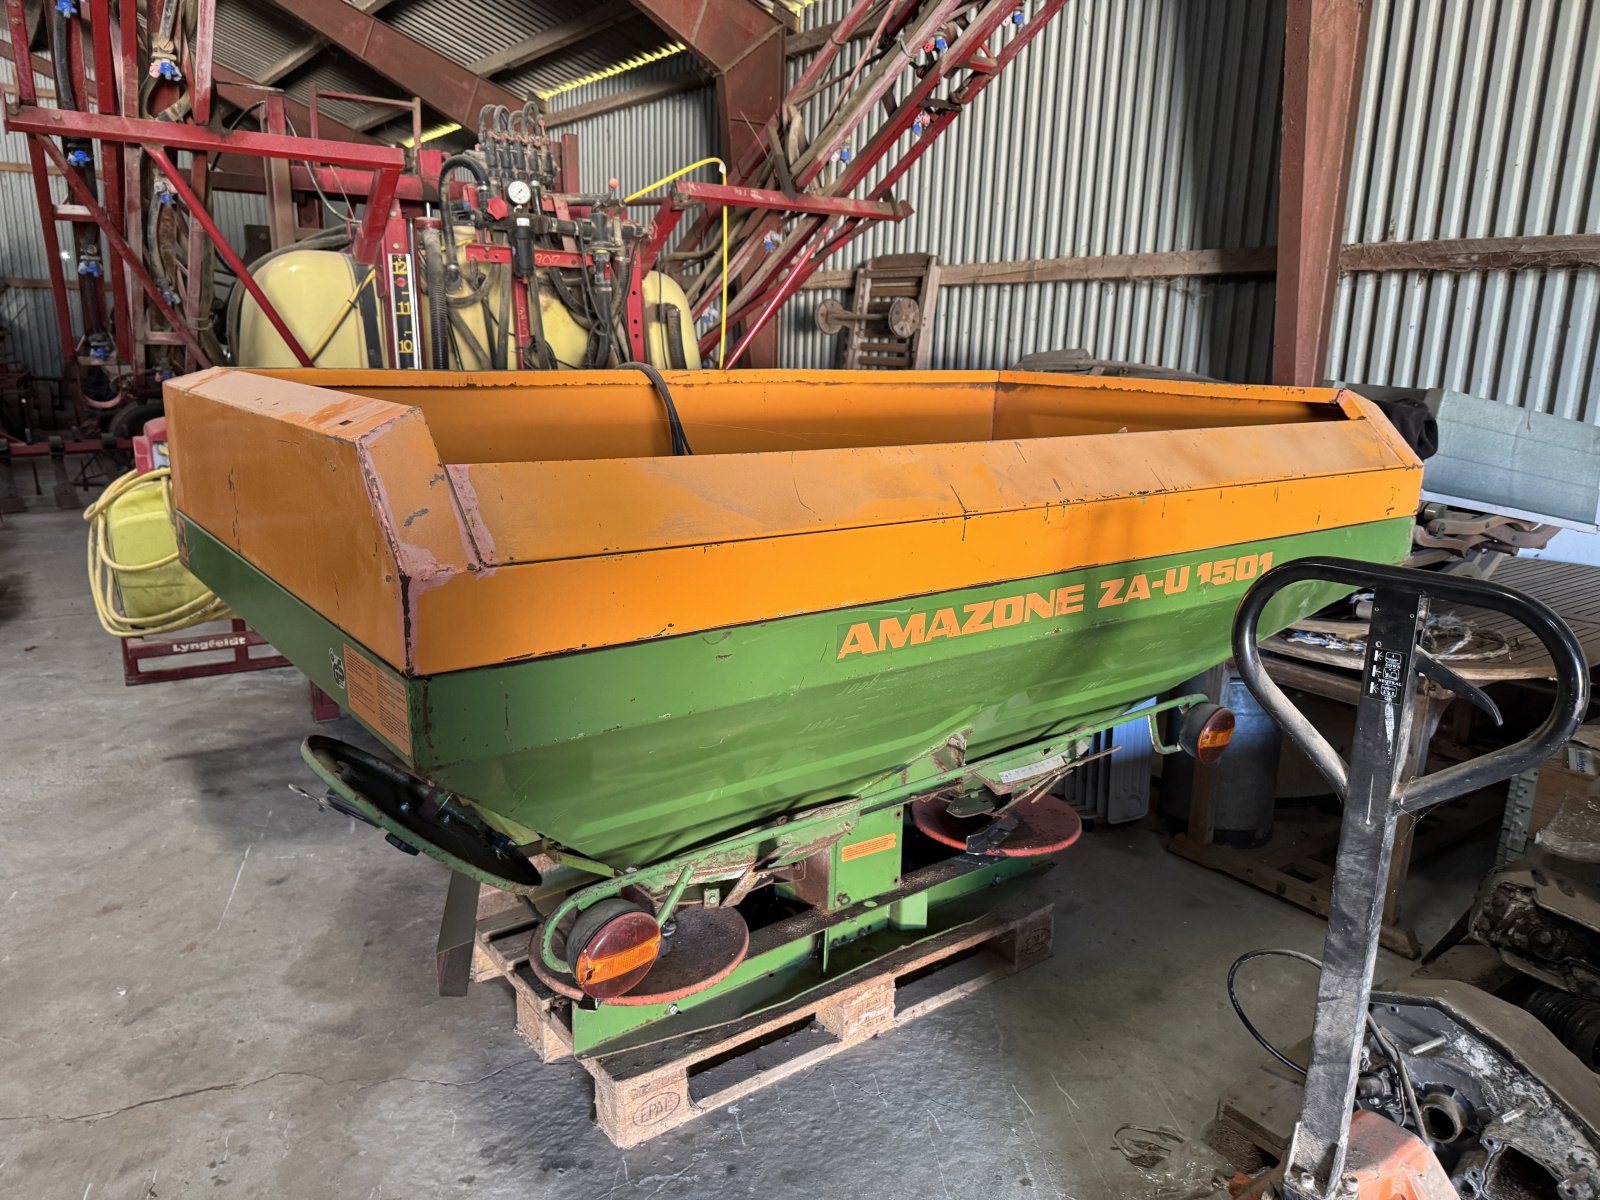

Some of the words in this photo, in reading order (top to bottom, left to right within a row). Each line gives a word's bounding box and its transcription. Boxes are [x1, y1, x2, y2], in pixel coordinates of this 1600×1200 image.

[392, 260, 407, 274] 12
[397, 301, 411, 315] 11
[399, 340, 413, 352] 10
[837, 583, 1085, 660] AMAZONE
[1098, 569, 1189, 609] ZA-U
[1197, 552, 1273, 585] 1501
[172, 637, 246, 652] Lyngfeldt
[640, 1097, 673, 1123] EPAL
